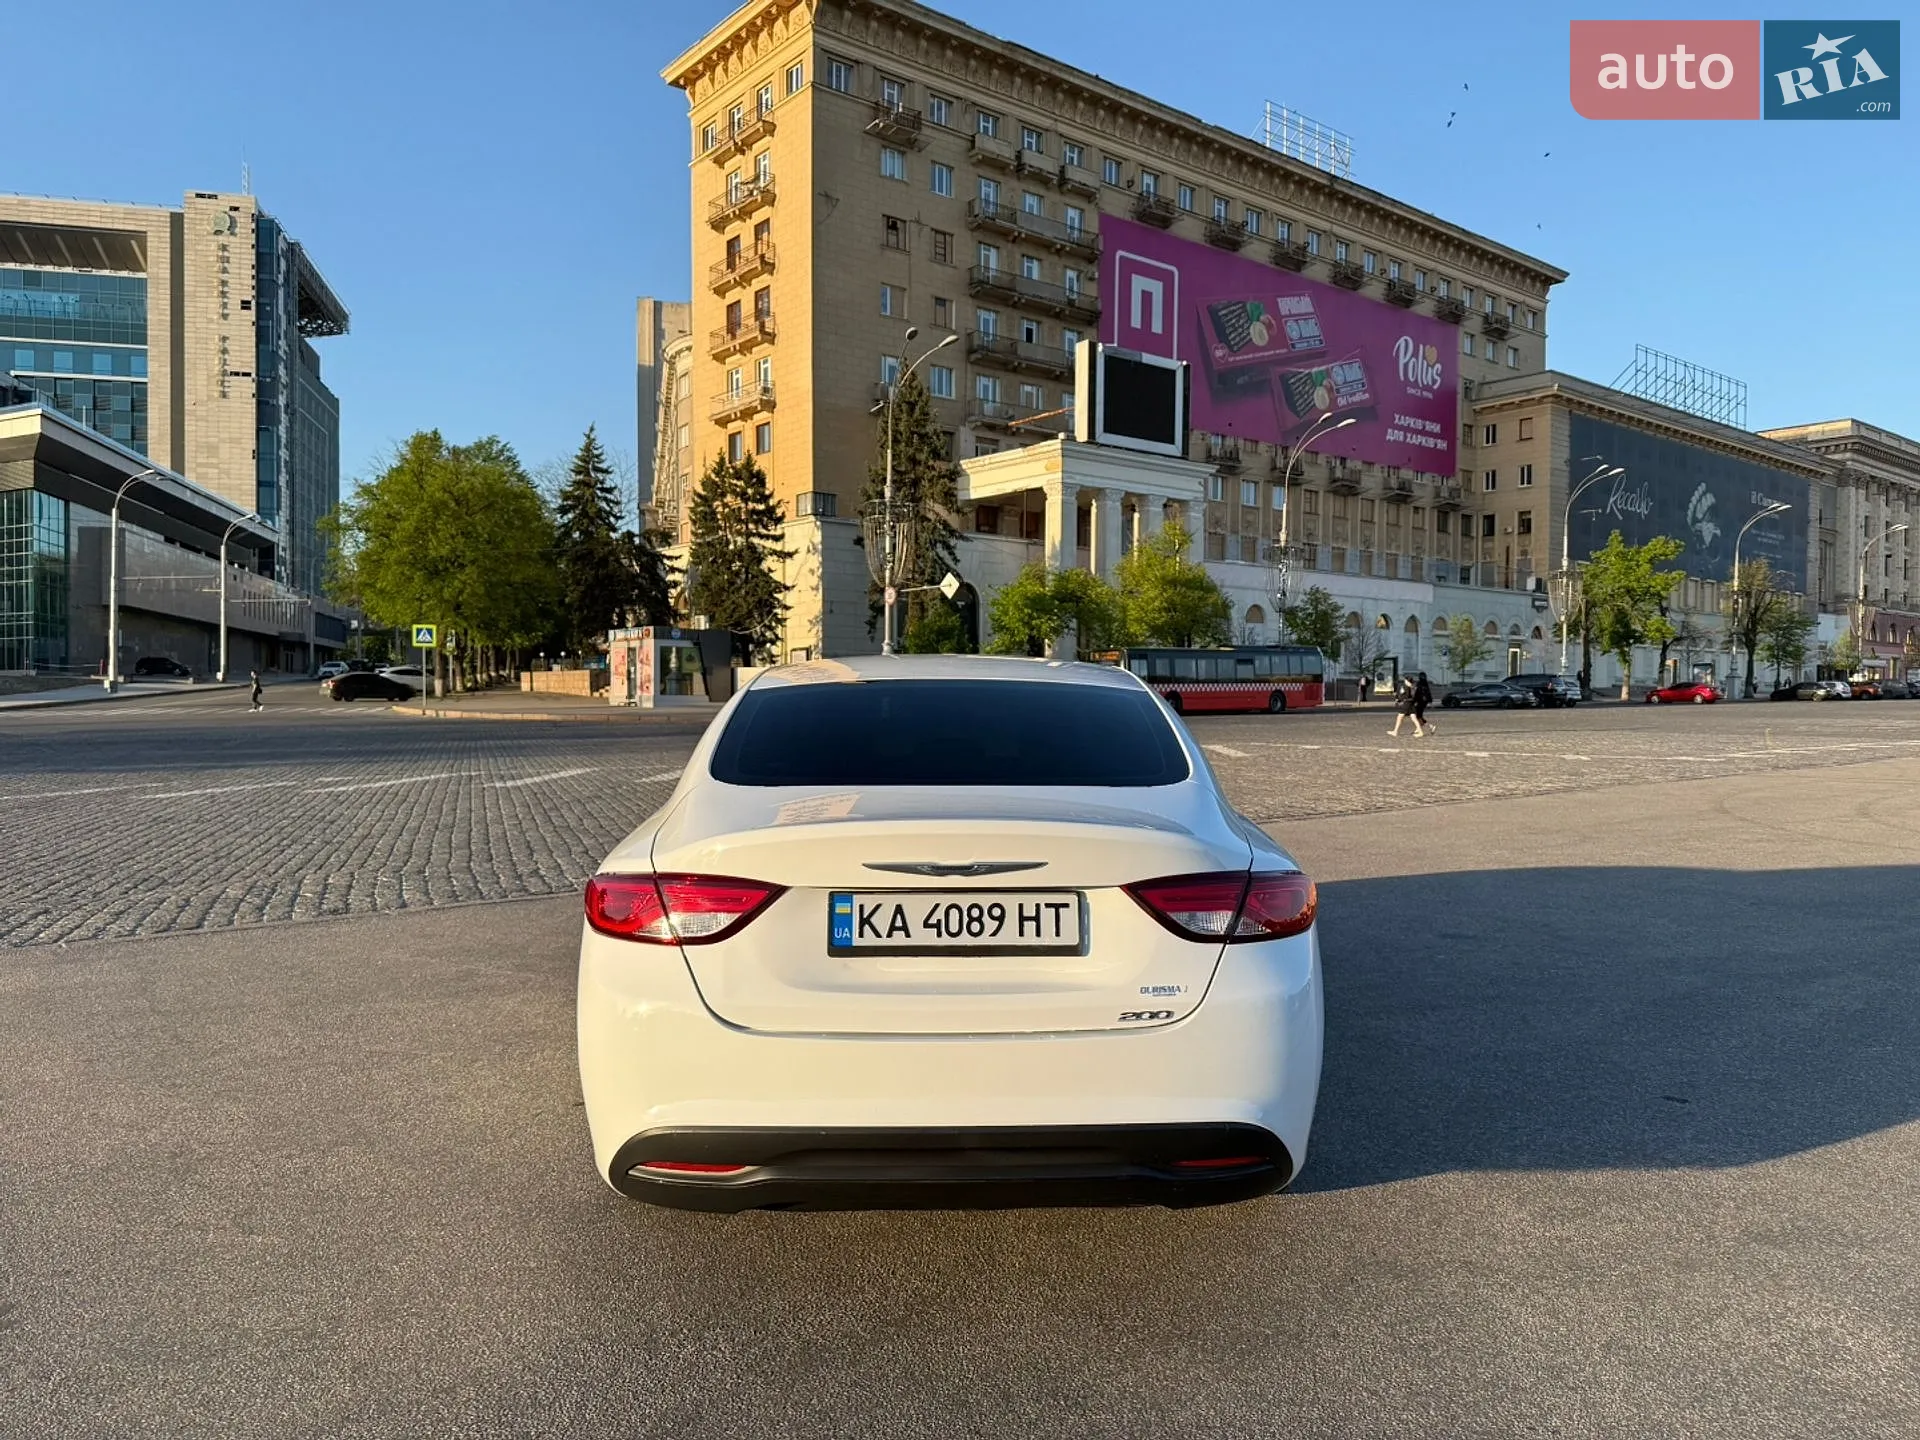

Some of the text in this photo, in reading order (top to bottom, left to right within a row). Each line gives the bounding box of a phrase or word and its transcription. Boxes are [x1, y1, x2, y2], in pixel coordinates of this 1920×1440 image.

[1393, 335, 1442, 390] Polus
[1386, 428, 1404, 443] ДЛЯ
[857, 902, 1070, 939] KA 4089 HT
[834, 927, 851, 940] UA
[1118, 1010, 1175, 1022] 200
